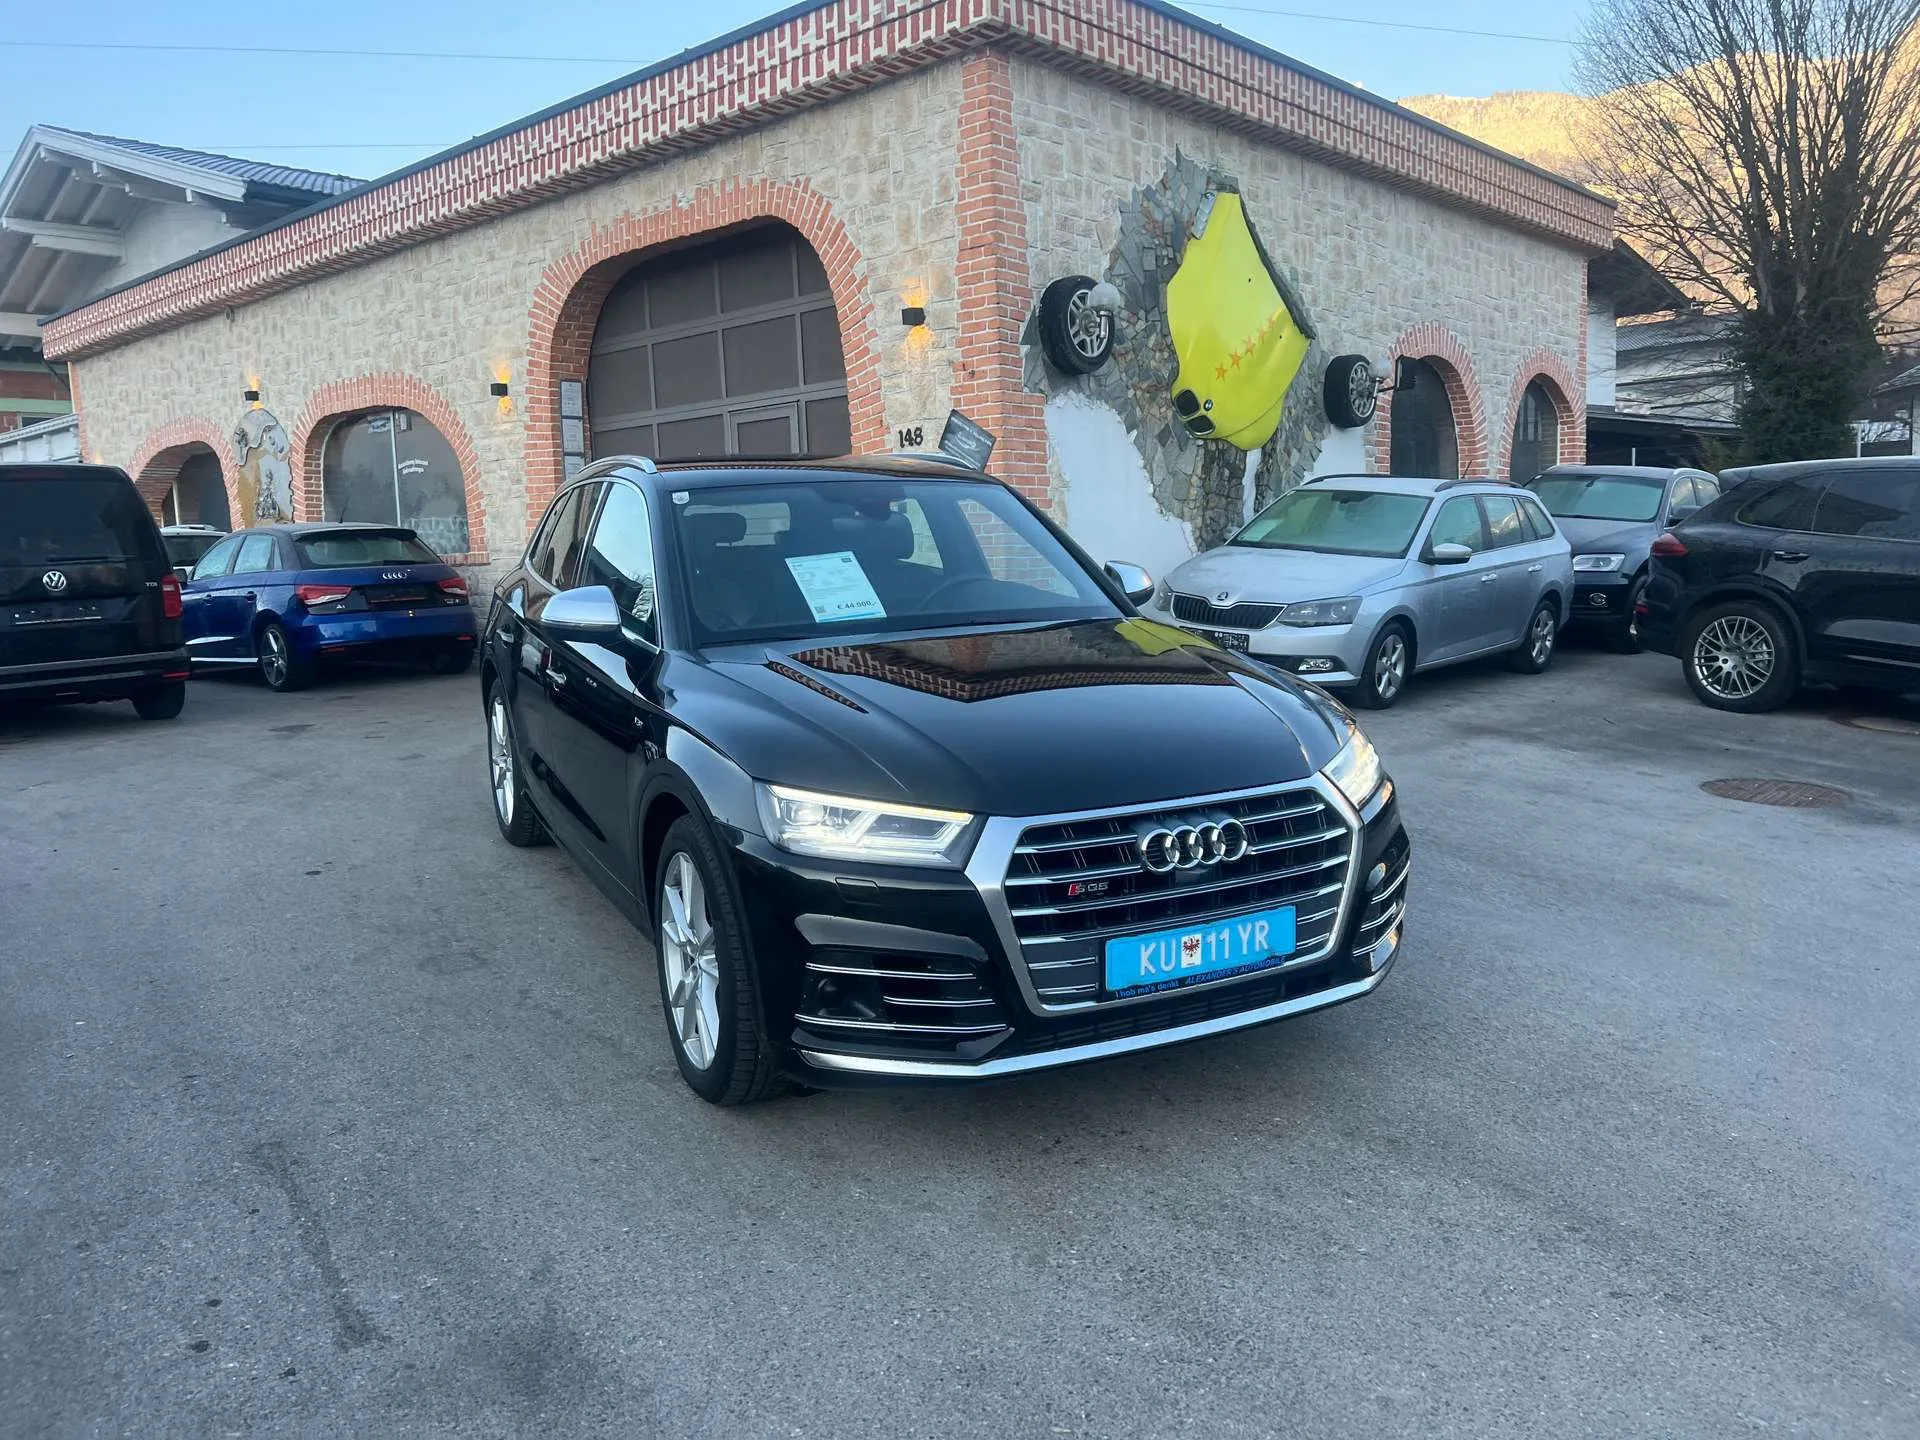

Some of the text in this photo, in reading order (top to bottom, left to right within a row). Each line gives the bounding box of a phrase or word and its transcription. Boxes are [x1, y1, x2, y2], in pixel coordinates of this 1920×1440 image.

[898, 427, 924, 448] 148
[1140, 920, 1269, 976] KU 11 YR
